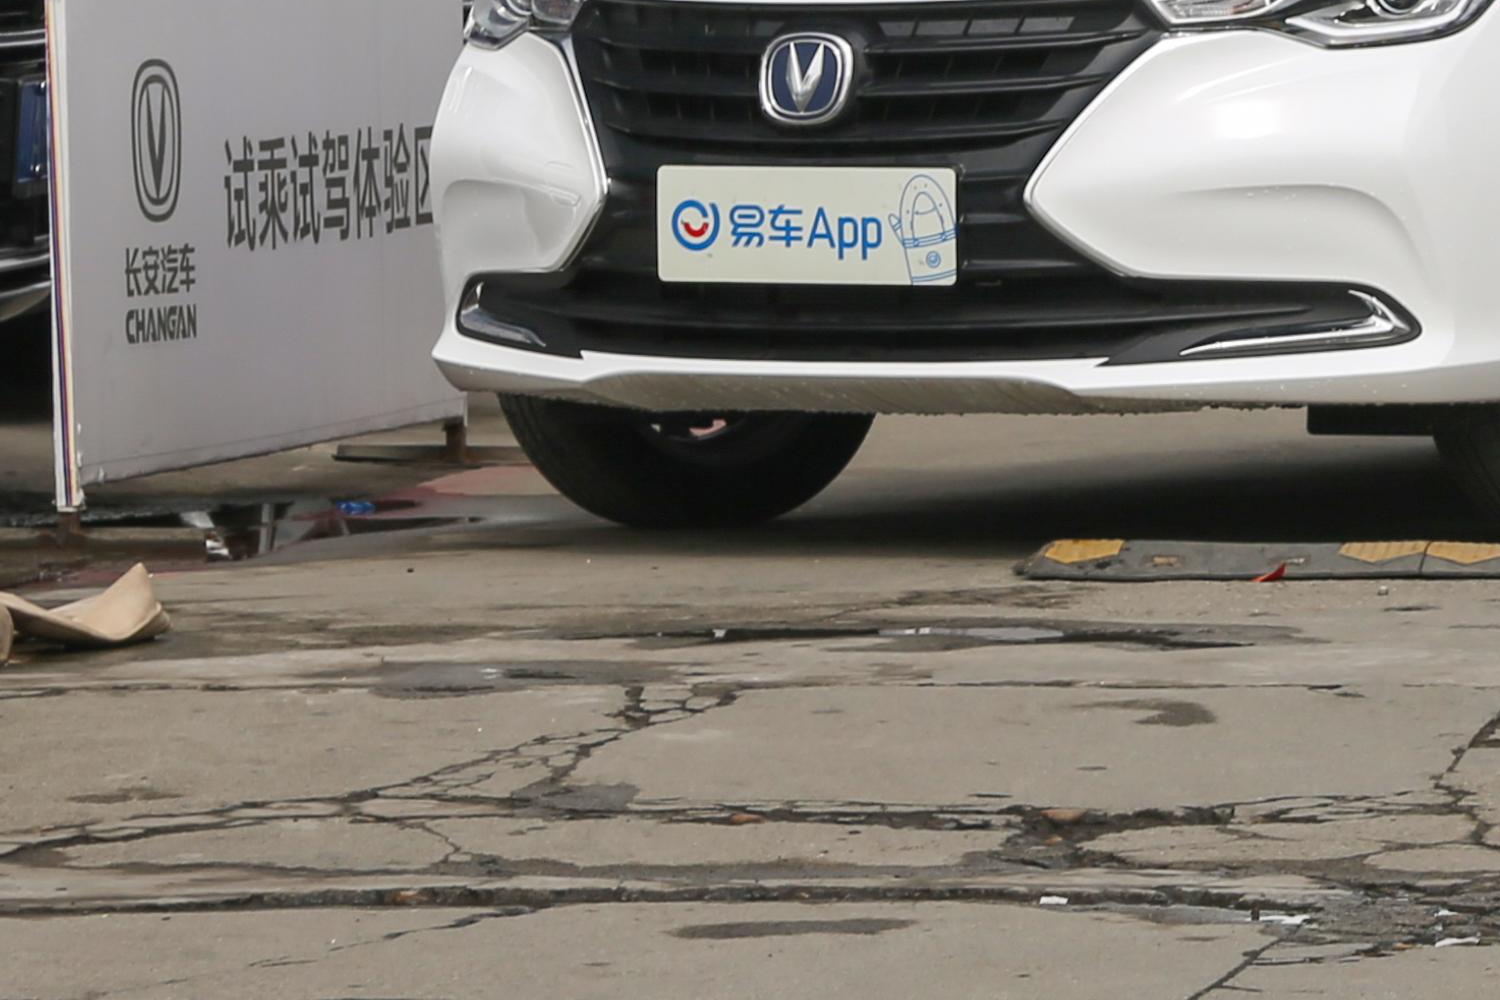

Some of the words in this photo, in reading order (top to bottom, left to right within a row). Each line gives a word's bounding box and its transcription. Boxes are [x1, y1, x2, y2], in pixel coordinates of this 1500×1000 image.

[224, 123, 434, 251] 试乘试驾体验区
[729, 204, 883, 261] 易车App
[125, 244, 197, 298] 长安汽车
[126, 304, 198, 344] CHANGAN
